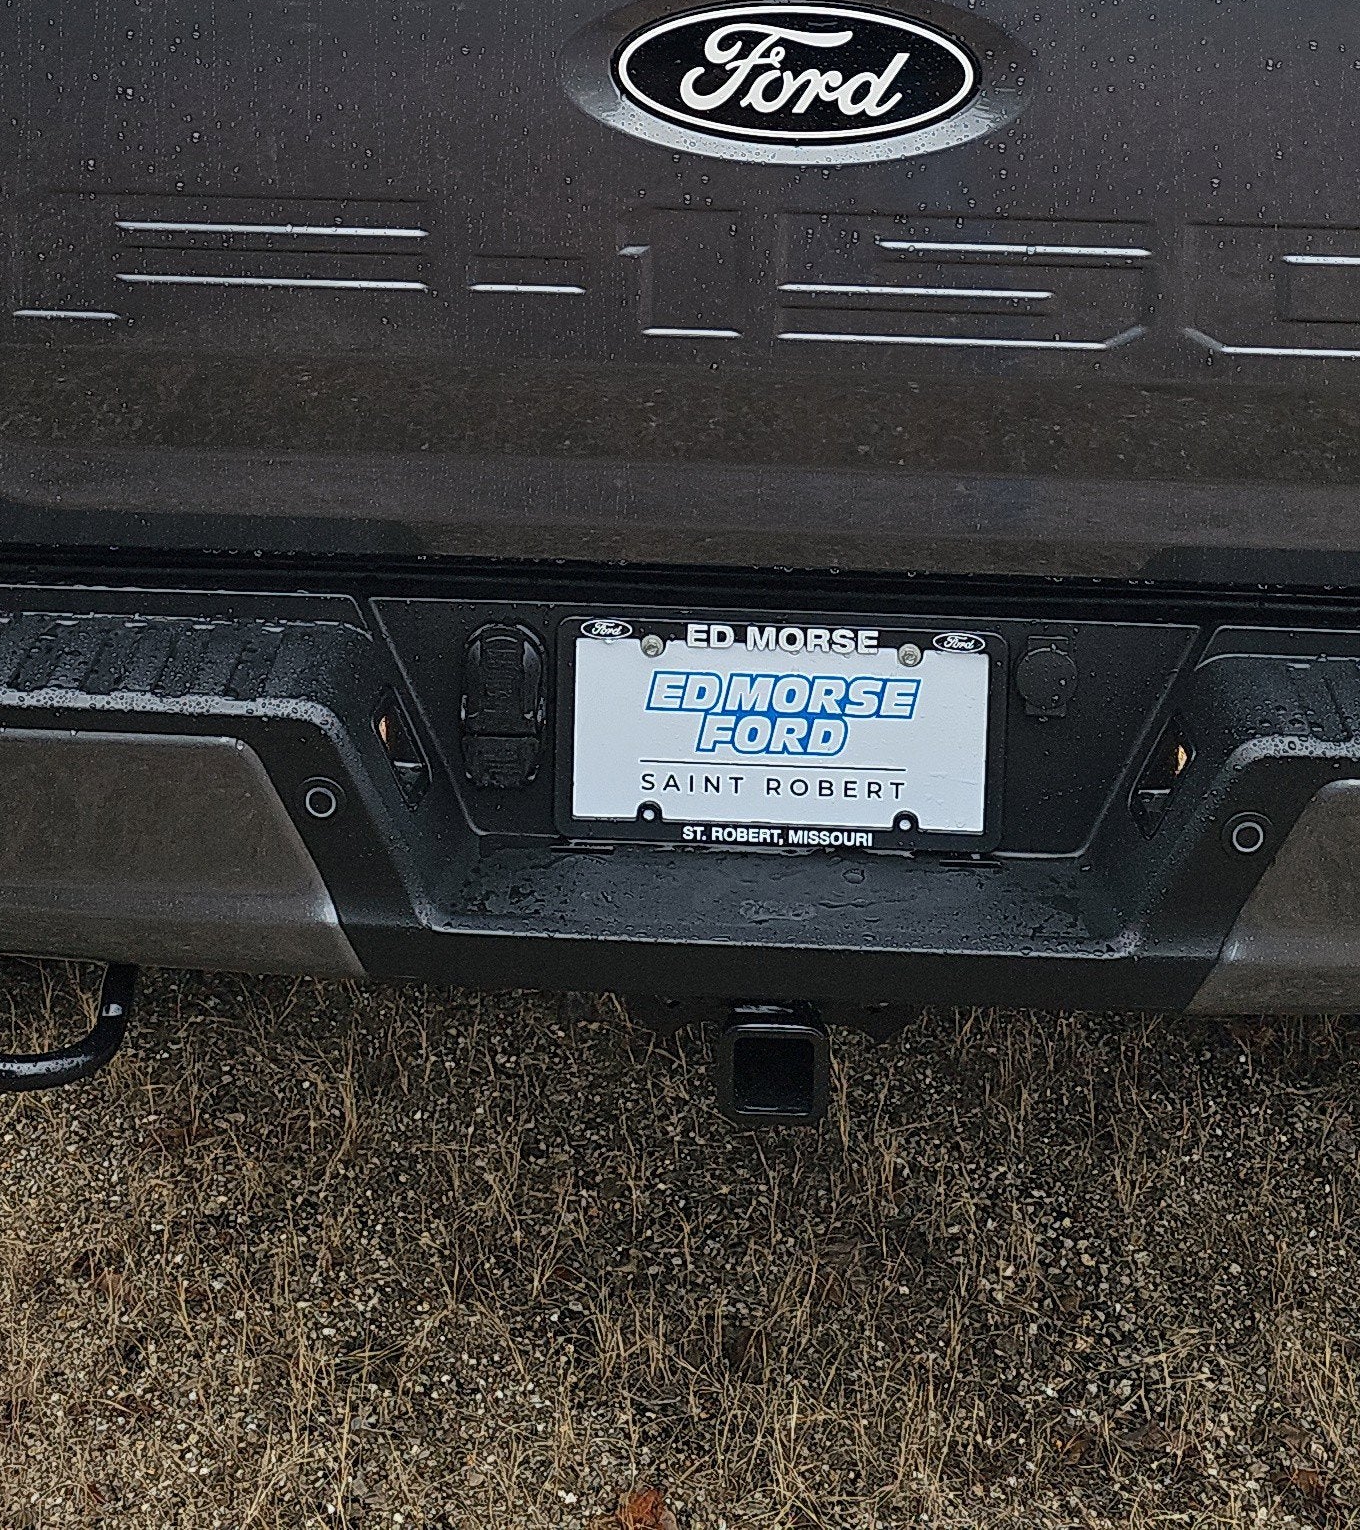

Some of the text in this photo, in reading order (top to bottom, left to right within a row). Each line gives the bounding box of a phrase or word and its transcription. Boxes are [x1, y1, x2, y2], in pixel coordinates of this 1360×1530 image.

[680, 23, 911, 117] Ford
[591, 621, 623, 636] Ford
[686, 623, 879, 655] ED MORSE
[943, 635, 976, 650] Ford
[646, 671, 921, 719] ED MORSE
[696, 714, 848, 756] FORD
[640, 773, 906, 800] SAINT ROBERT
[682, 825, 873, 847] ST. ROBERT, MISSOURI
